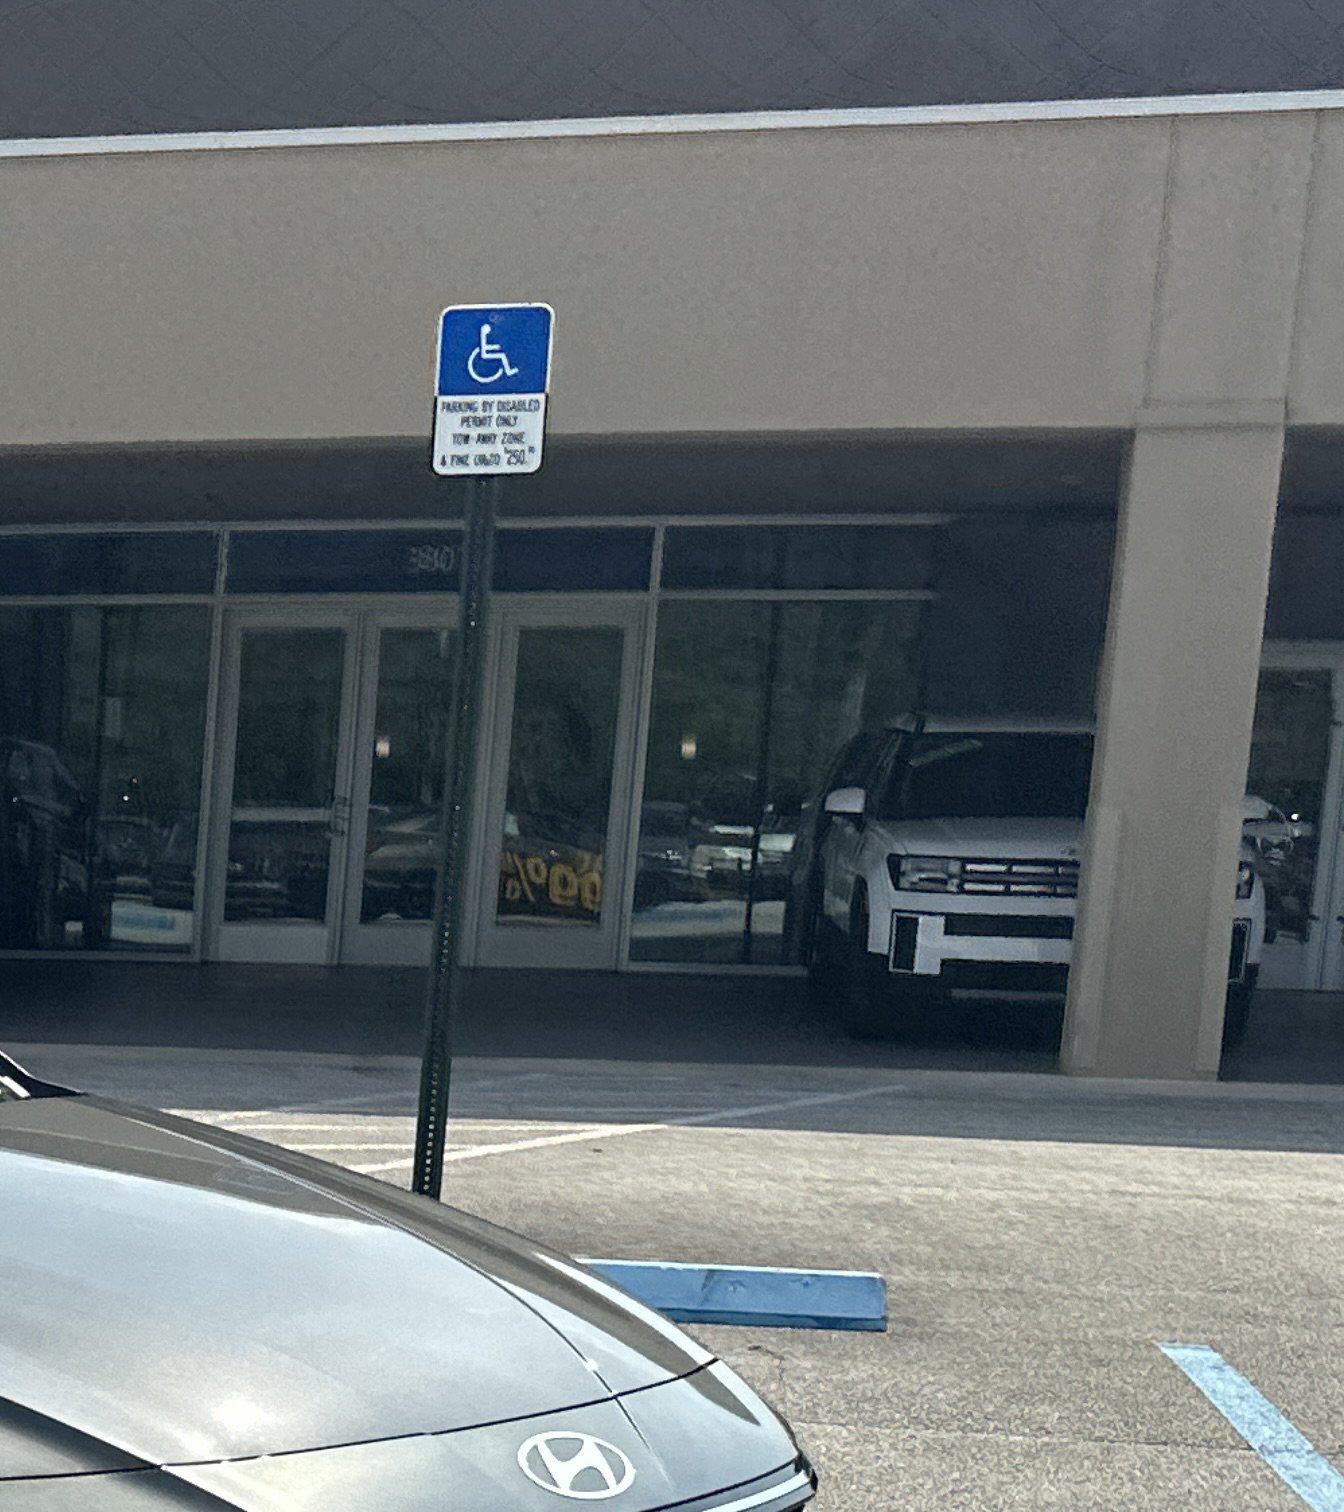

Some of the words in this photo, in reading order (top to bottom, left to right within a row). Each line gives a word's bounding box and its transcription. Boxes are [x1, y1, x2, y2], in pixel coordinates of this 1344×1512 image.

[442, 400, 478, 413] PARKING
[482, 400, 494, 413] BY
[497, 399, 540, 413] DISABLED
[461, 415, 493, 428] PERMIT
[496, 414, 518, 428] ONLY
[501, 431, 526, 445] ZONE
